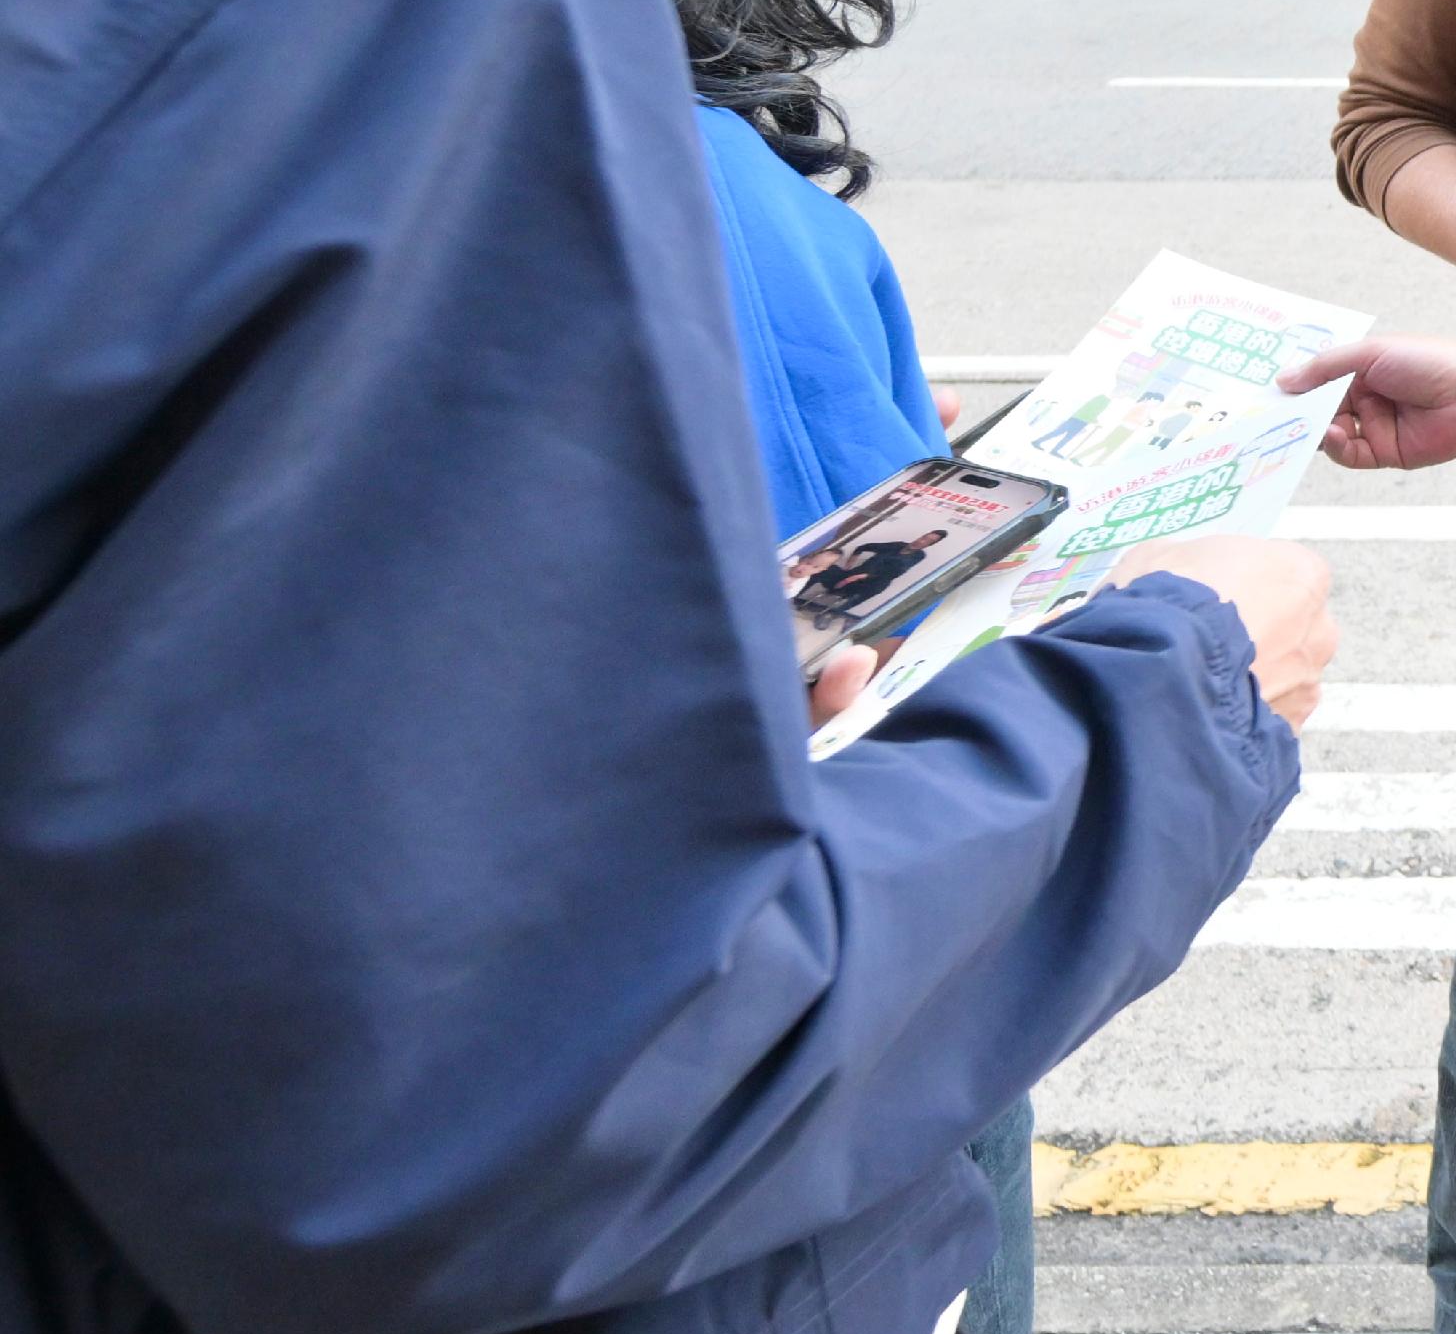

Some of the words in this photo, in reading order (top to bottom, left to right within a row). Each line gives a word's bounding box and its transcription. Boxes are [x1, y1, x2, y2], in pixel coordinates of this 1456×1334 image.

[1189, 312, 1280, 357] 香港的
[1108, 465, 1236, 523] 香港的
